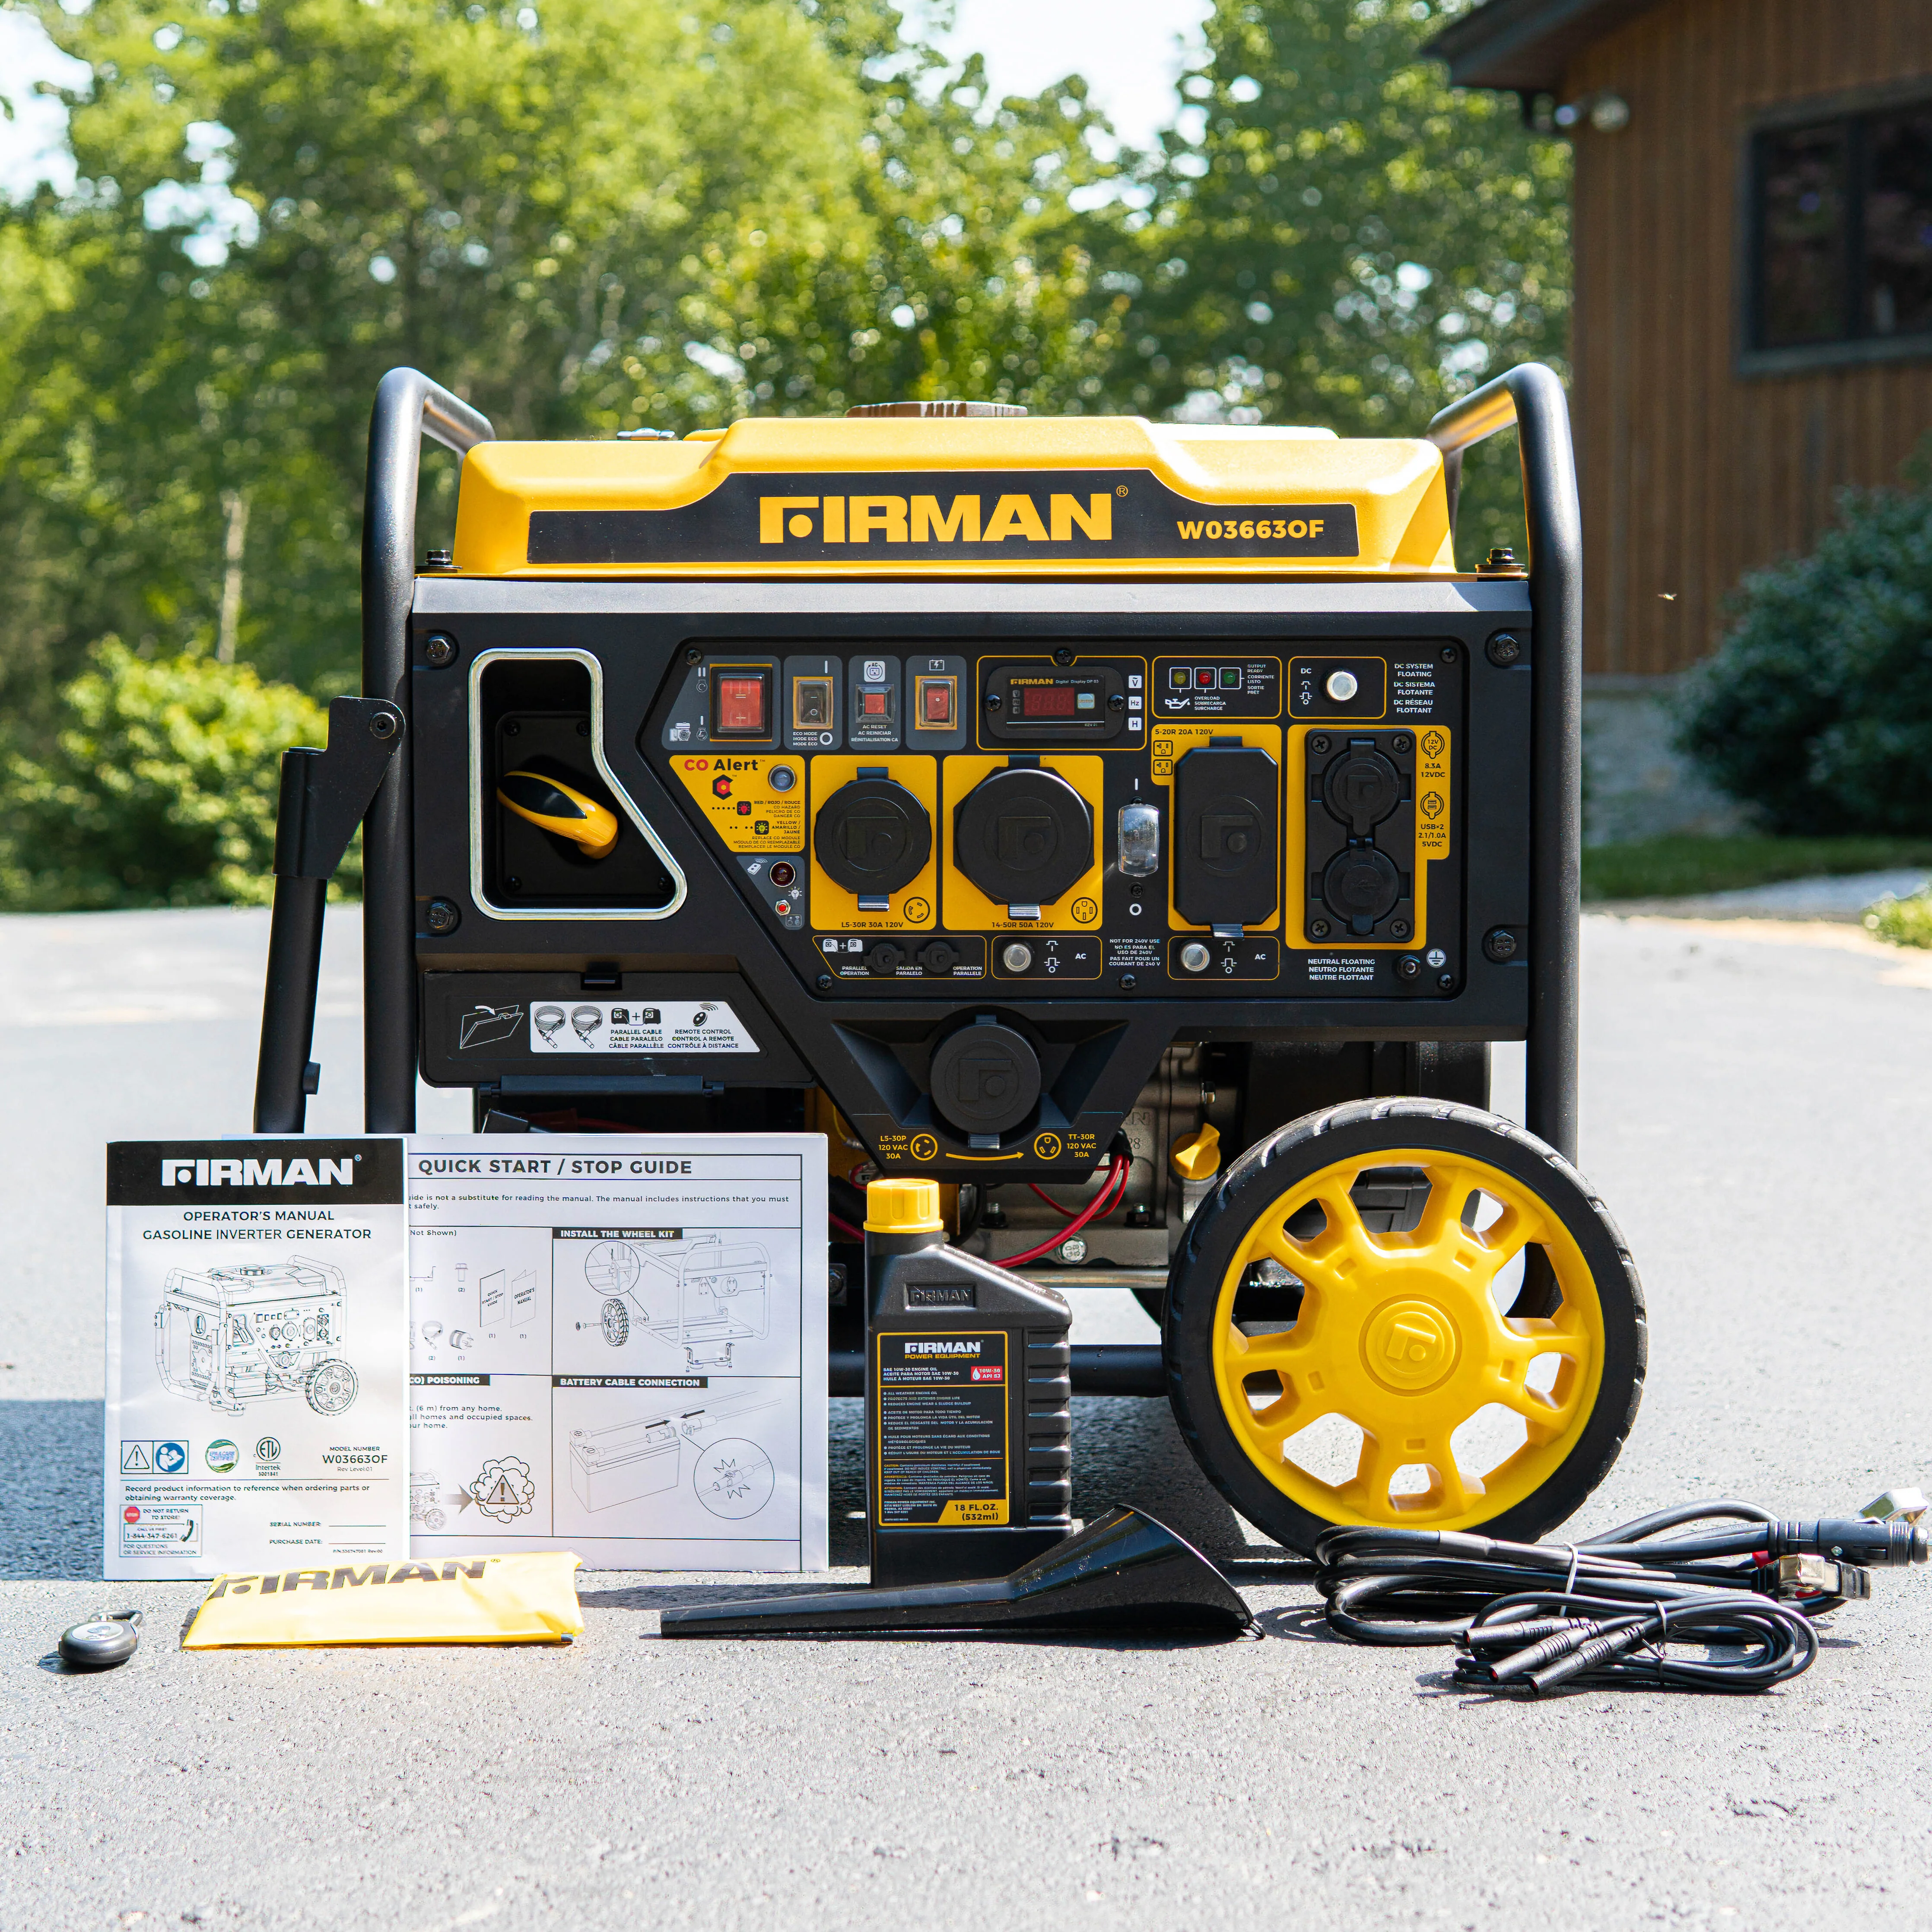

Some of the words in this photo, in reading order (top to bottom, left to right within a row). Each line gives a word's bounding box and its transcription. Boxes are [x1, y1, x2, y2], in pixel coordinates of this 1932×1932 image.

[759, 494, 1112, 543] FIRMAN
[684, 759, 709, 771] CO
[713, 758, 758, 771] Alert
[162, 1159, 353, 1186] FIRMAN
[419, 1160, 482, 1176] QUICK
[489, 1160, 551, 1173] START
[571, 1160, 623, 1174] STOP
[630, 1160, 692, 1174] GUIDE
[183, 1211, 271, 1221] OPERATOR'S
[275, 1211, 334, 1220] MANUAL
[143, 1230, 212, 1239] GASOLINE
[216, 1229, 282, 1239] INVERTER
[286, 1229, 371, 1239] GENERATOR
[601, 1230, 620, 1238] THE
[658, 1230, 675, 1238] KIT
[427, 1376, 480, 1384] POISONING
[560, 1378, 603, 1386] BATTERY
[604, 1378, 636, 1387] CABLE
[638, 1379, 700, 1387] CONNECTION
[962, 1512, 998, 1521] (532ml)
